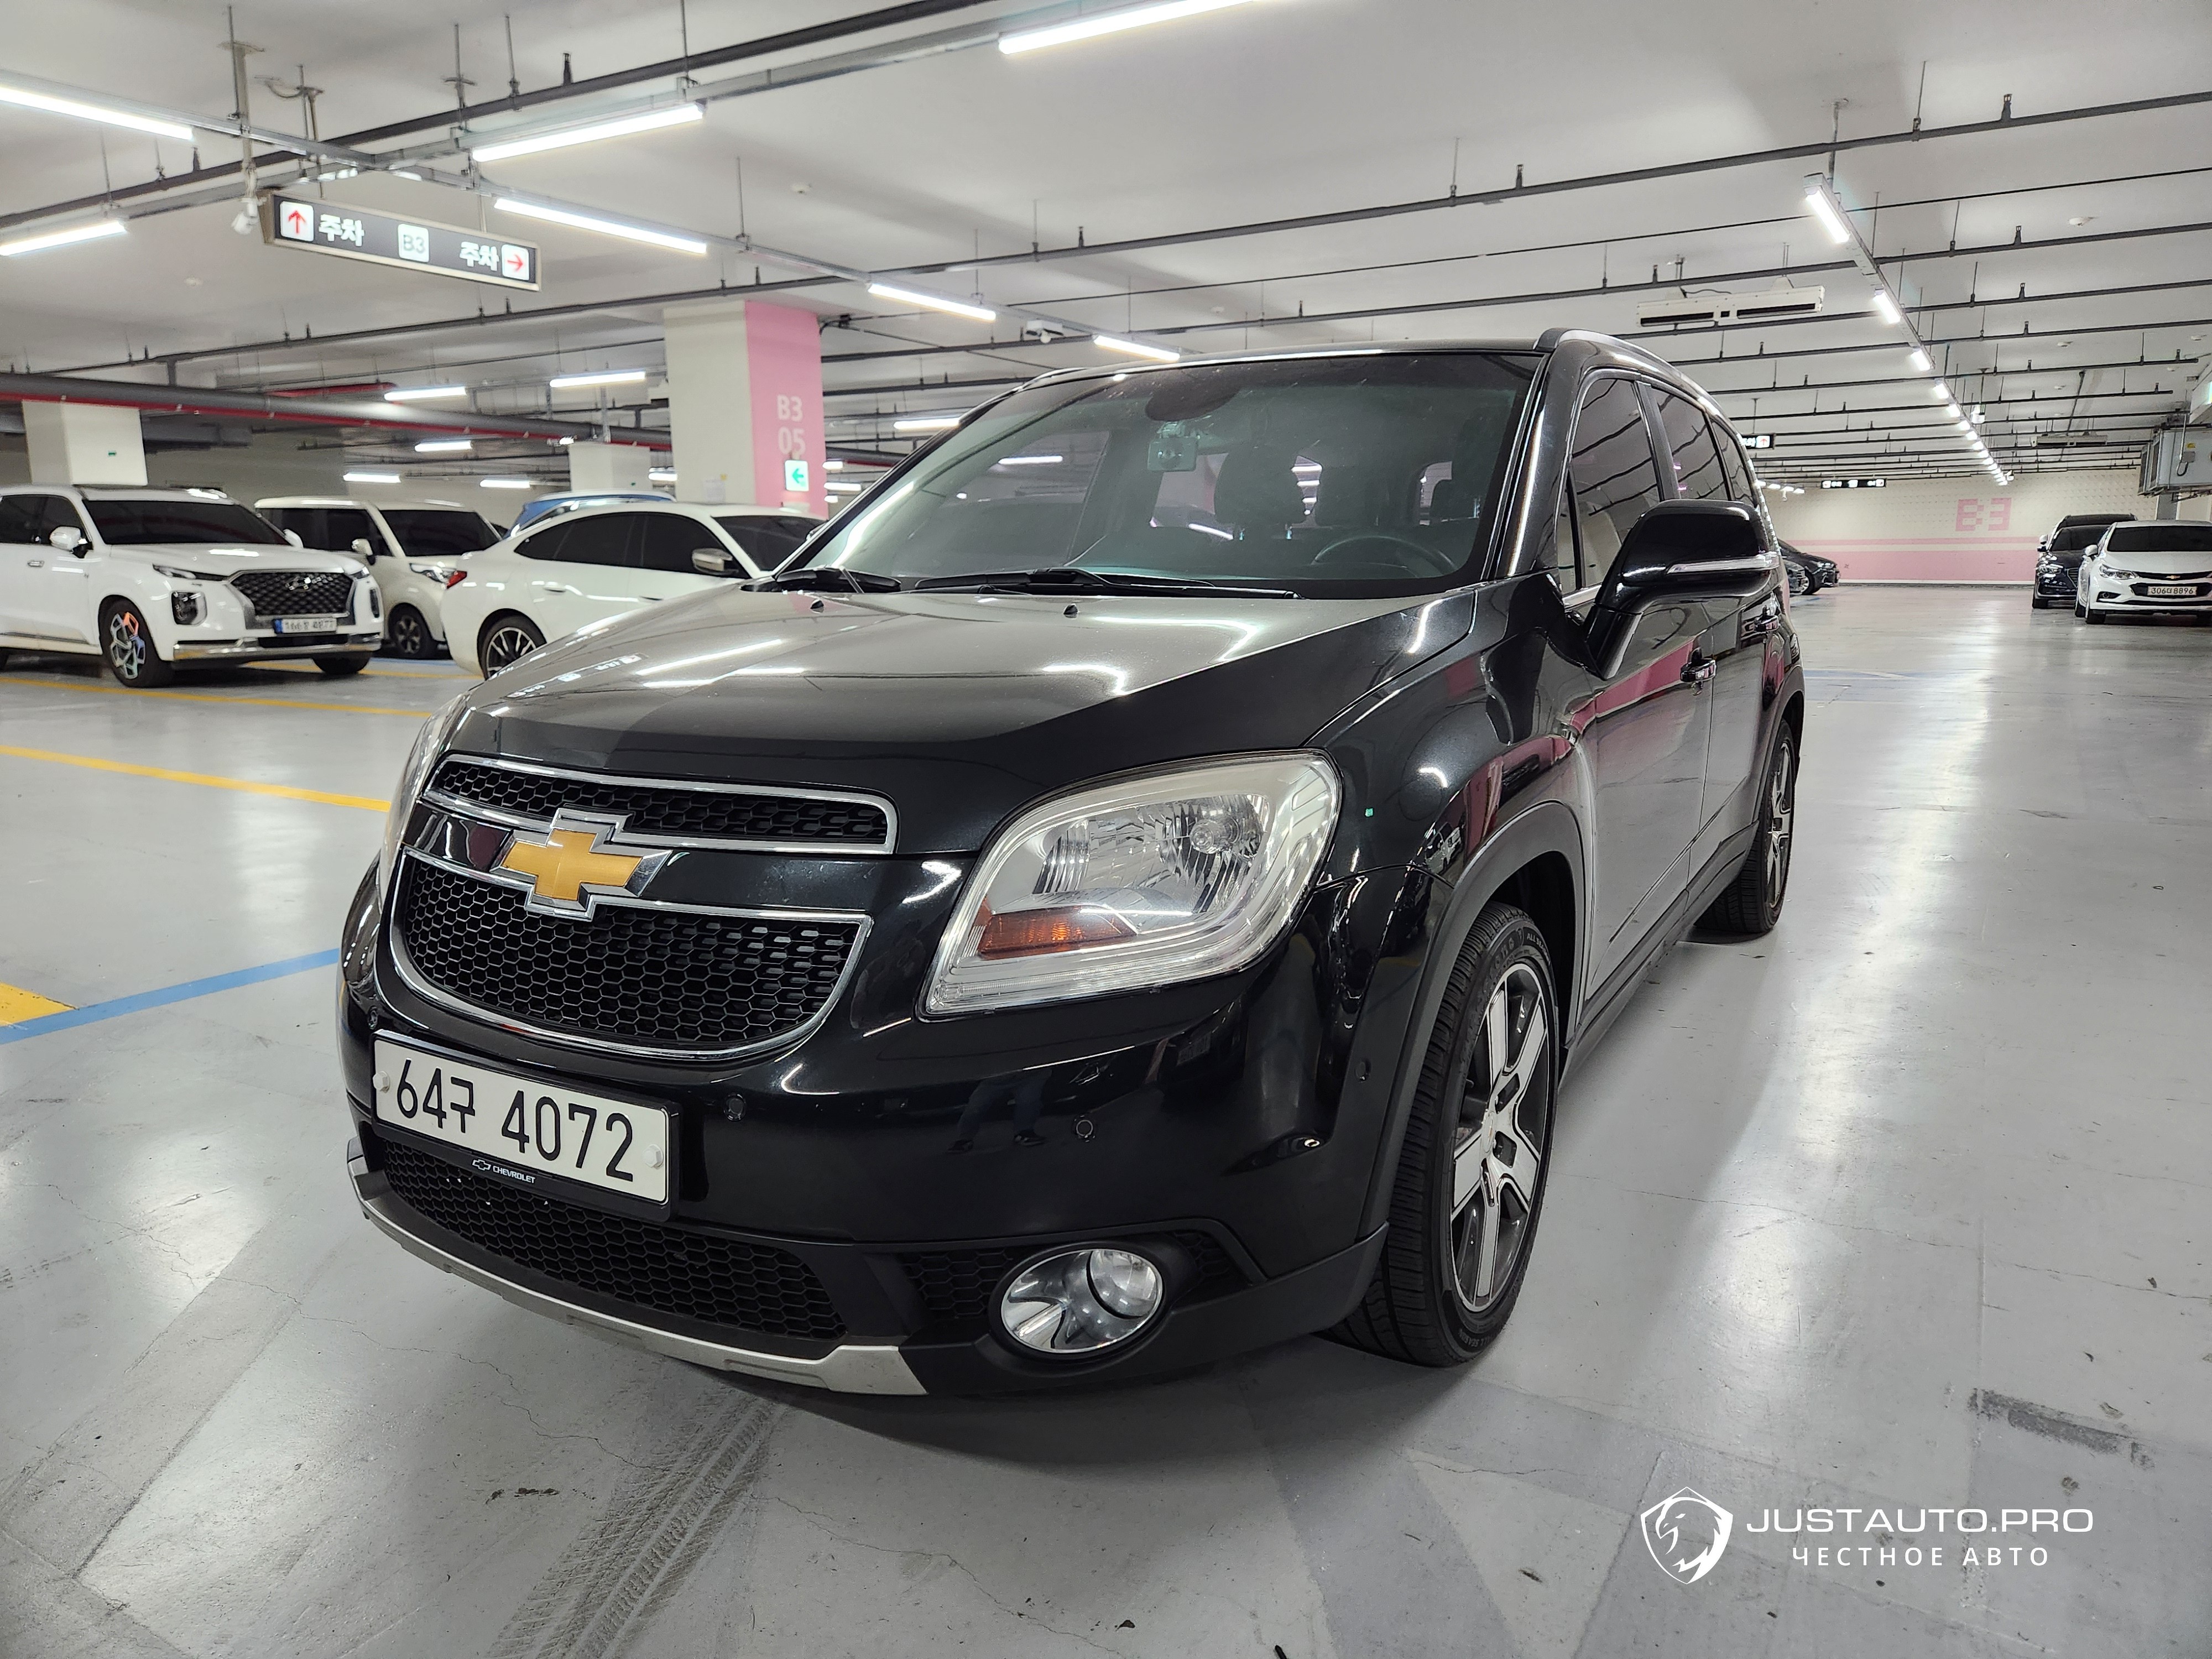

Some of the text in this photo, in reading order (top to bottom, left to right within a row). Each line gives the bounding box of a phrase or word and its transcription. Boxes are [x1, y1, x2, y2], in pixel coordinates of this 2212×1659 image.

[319, 213, 365, 247] 주차
[403, 234, 426, 254] B3
[460, 241, 499, 272] 주차
[777, 394, 804, 422] B3
[778, 426, 806, 455] 05
[1955, 497, 2012, 531] B3
[1526, 932, 1536, 942] ALL
[397, 1058, 634, 1183] 64구 4072
[493, 1165, 536, 1183] CHEVROLET
